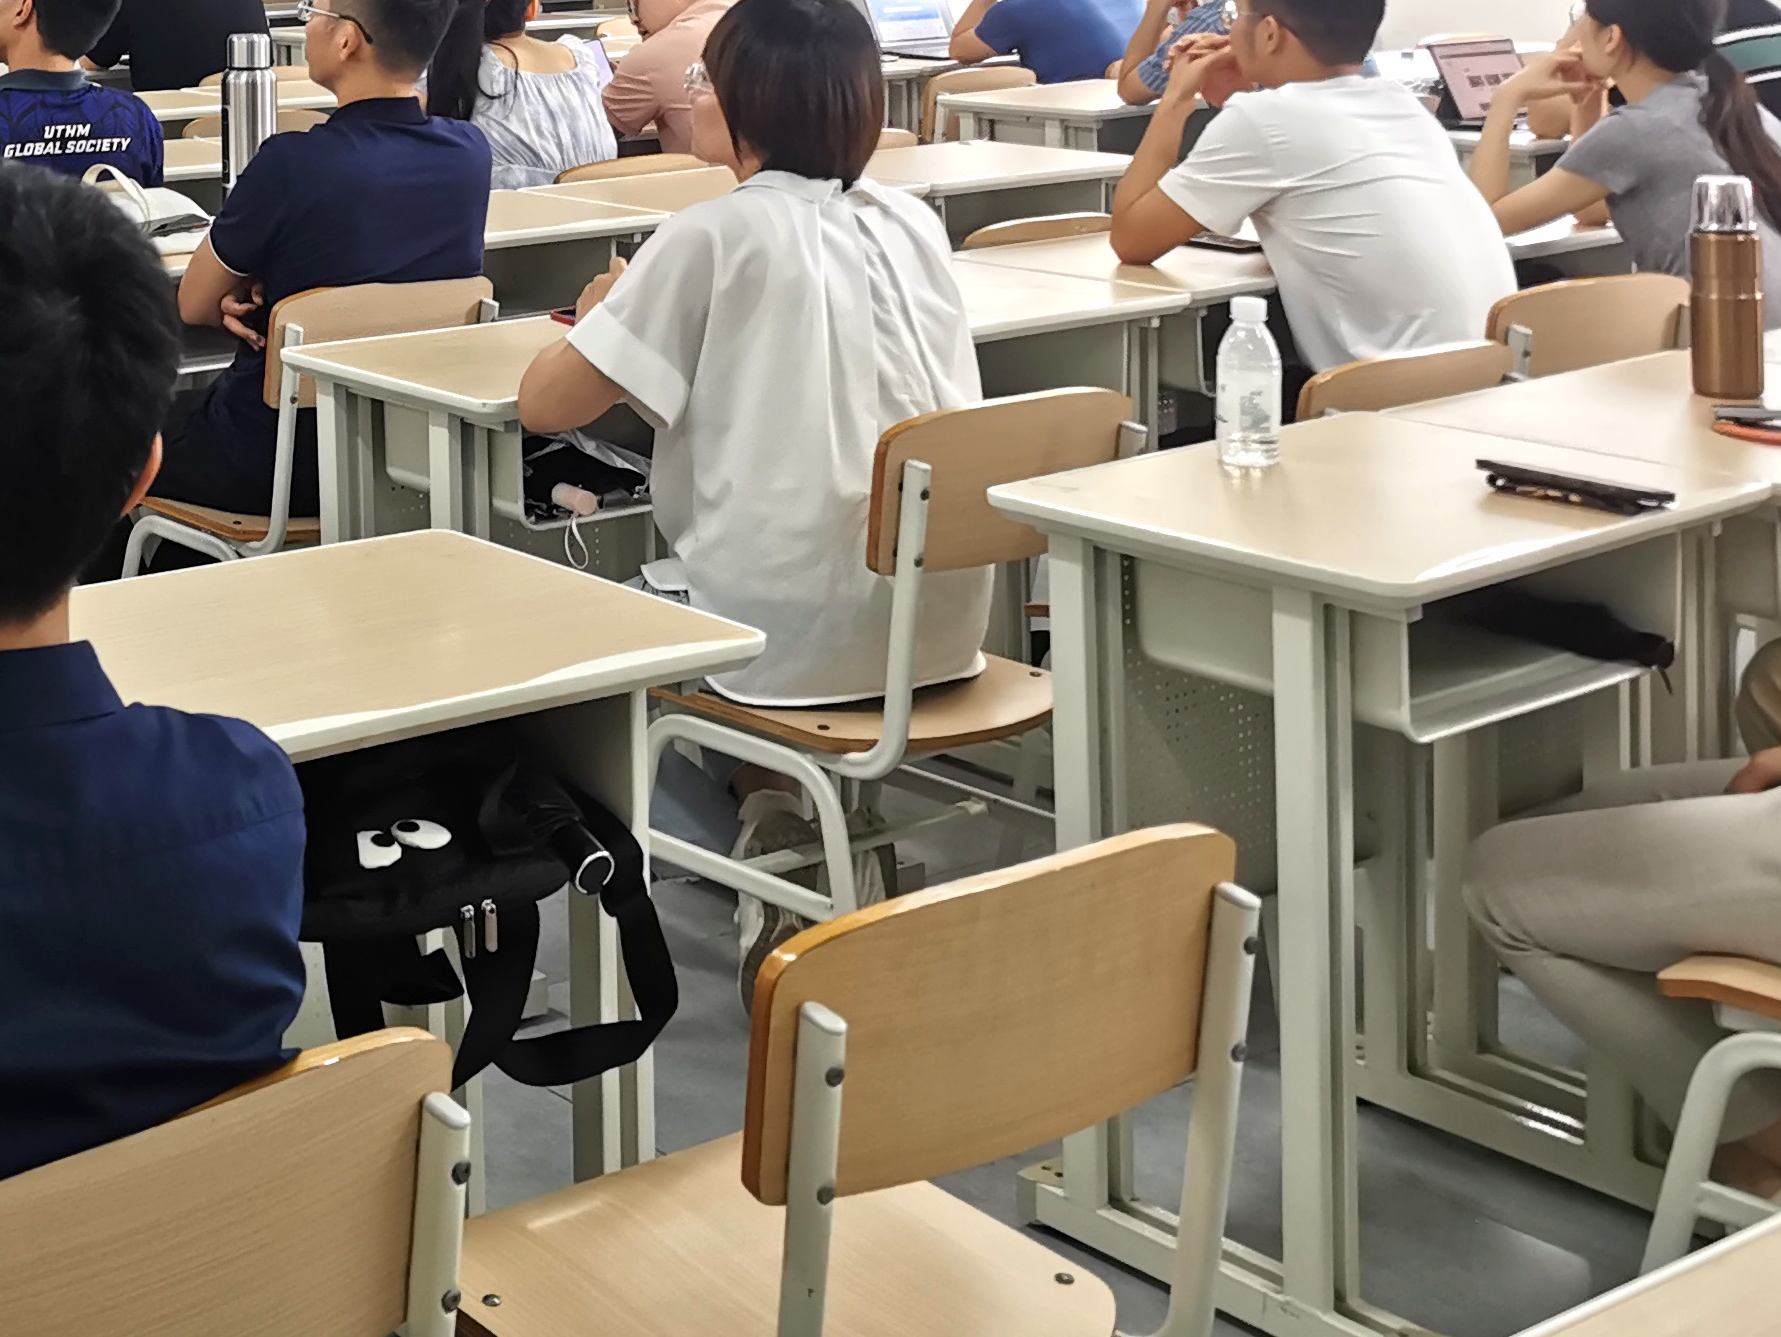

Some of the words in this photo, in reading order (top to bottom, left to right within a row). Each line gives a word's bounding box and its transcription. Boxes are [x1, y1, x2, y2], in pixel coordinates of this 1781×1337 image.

[44, 124, 91, 139] UTHM
[4, 140, 63, 157] GLOBAL
[65, 137, 131, 153] SOCIETY
